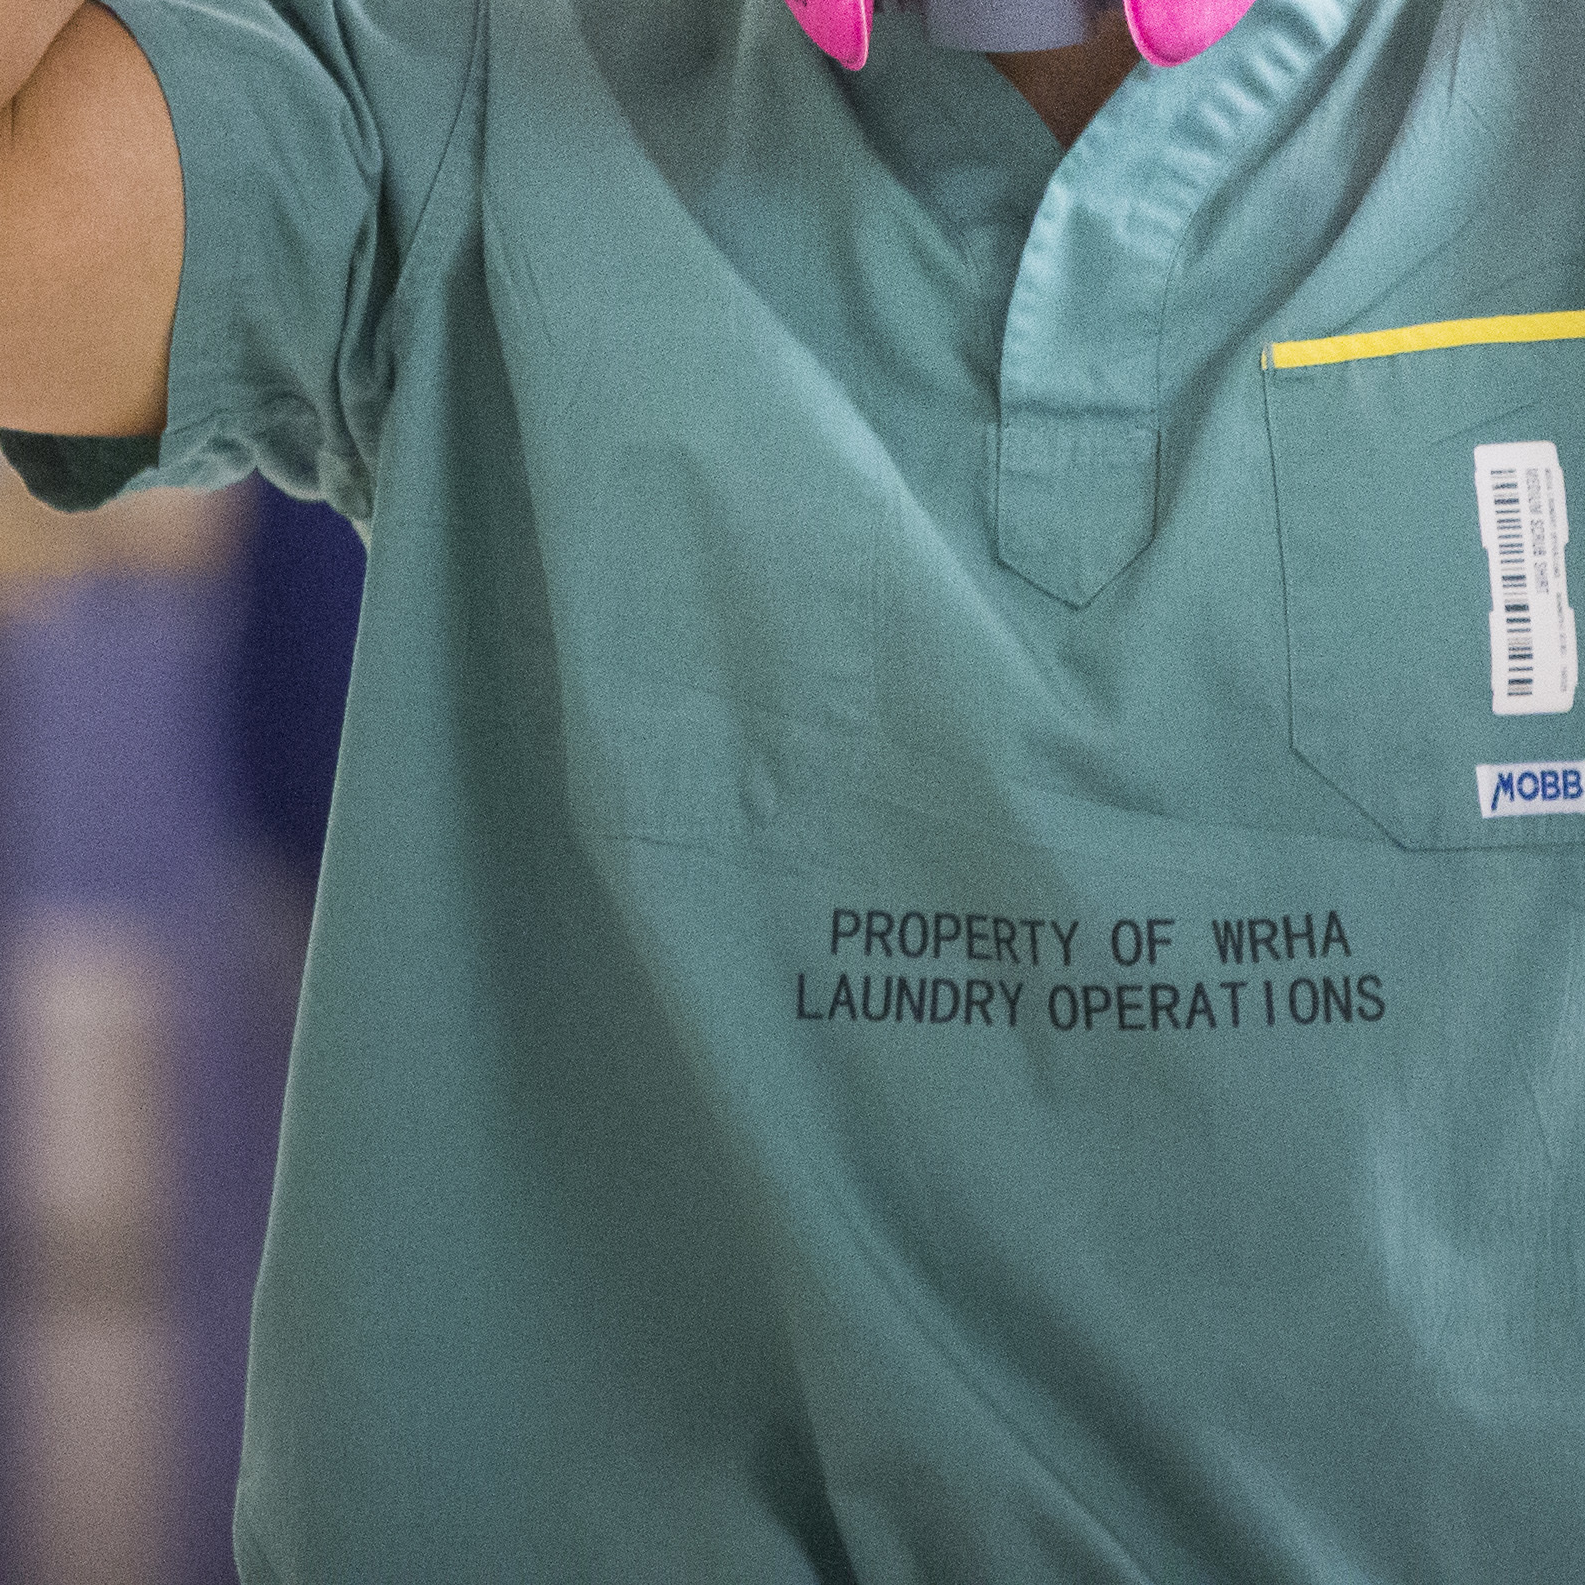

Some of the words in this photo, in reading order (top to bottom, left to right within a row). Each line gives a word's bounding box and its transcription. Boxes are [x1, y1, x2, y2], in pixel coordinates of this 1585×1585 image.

[1490, 769, 1584, 812] MOBB
[830, 908, 1080, 967] PROPERTY
[1111, 917, 1176, 967] OF
[1212, 910, 1353, 965] WRHA
[795, 972, 1024, 1027] LAUNDRY
[1047, 972, 1387, 1031] OPERATIONS
